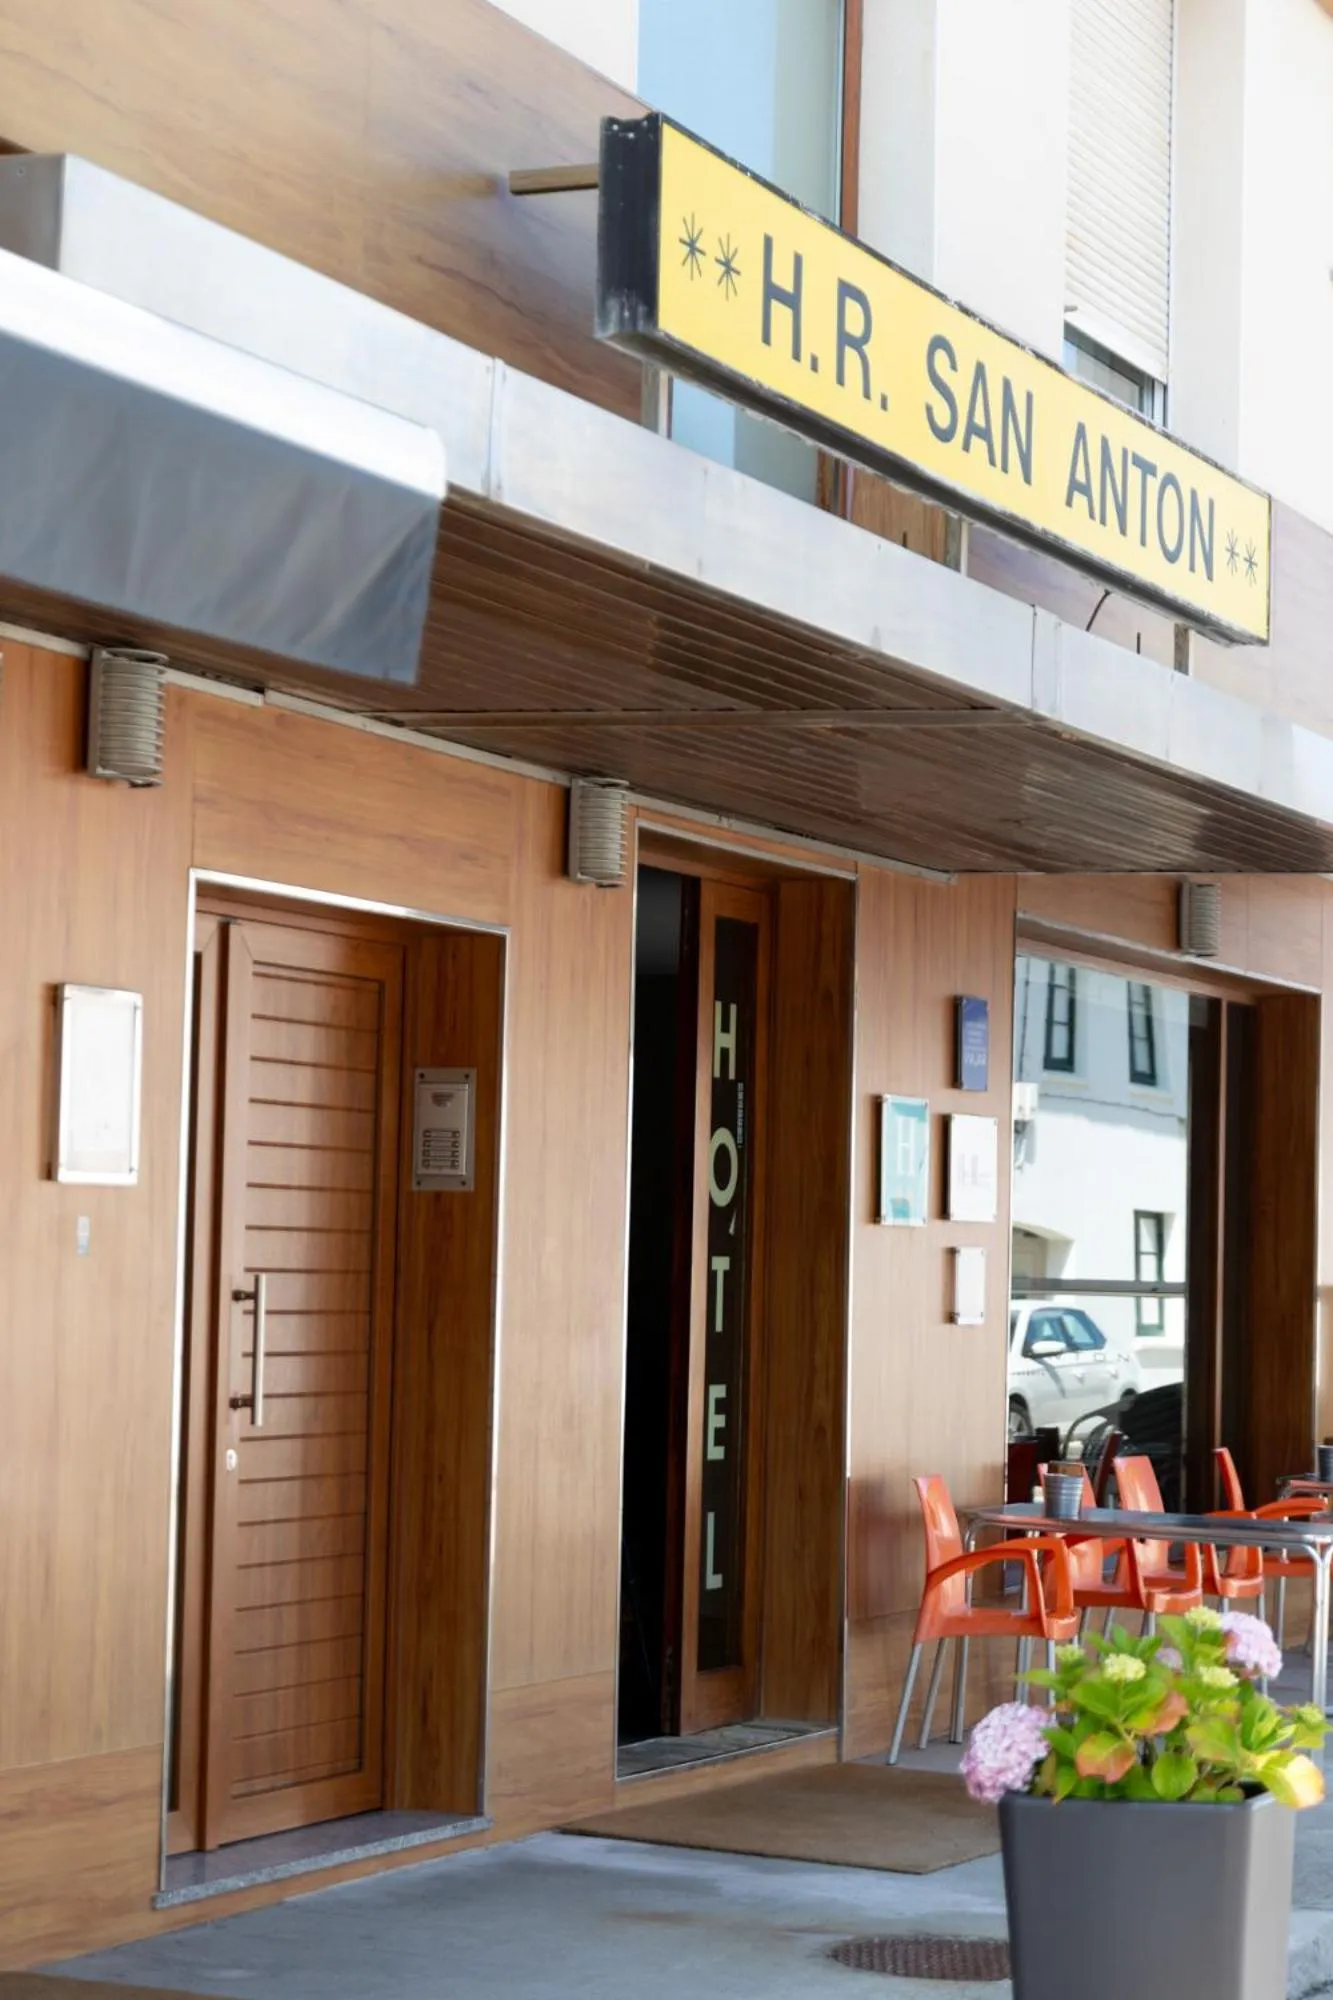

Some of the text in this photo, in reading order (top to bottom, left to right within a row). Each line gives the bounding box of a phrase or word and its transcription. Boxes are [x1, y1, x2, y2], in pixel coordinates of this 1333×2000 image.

[761, 233, 1217, 583] H.R. SAN ANTON
[706, 1001, 739, 1590] HOTEL
